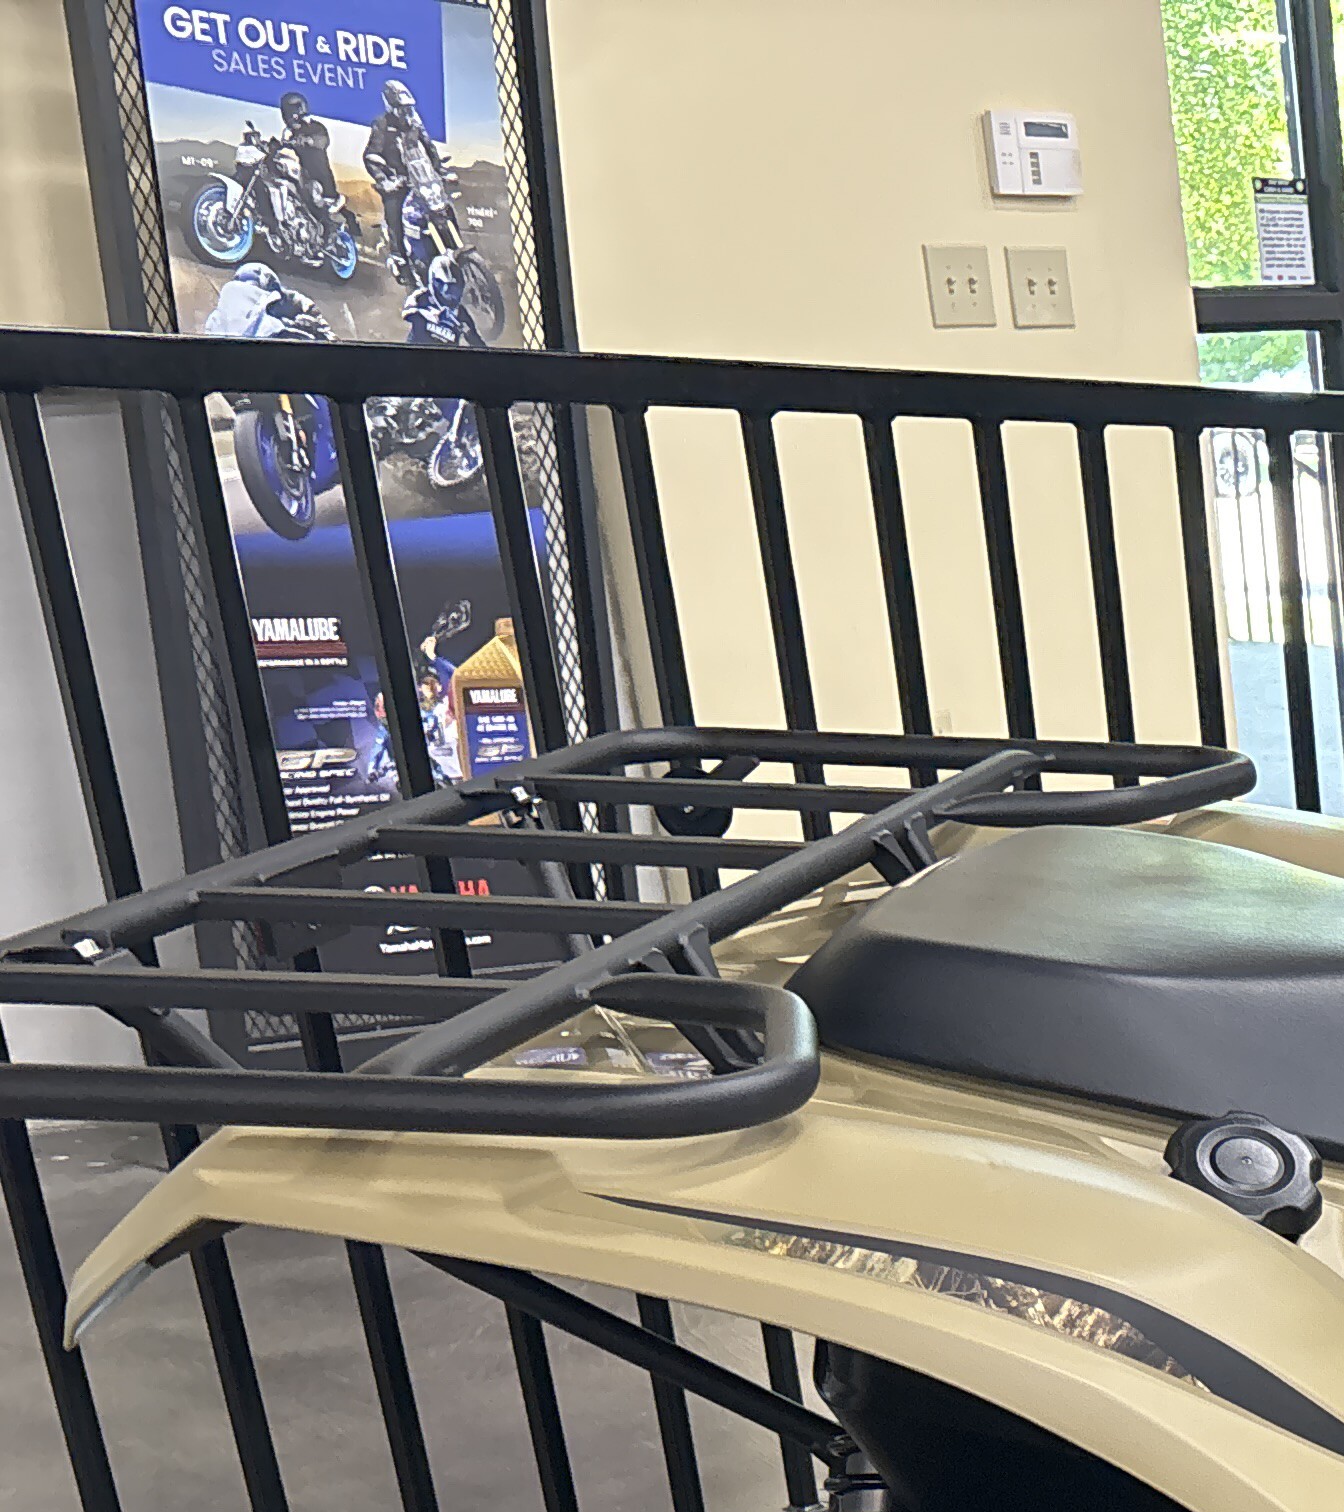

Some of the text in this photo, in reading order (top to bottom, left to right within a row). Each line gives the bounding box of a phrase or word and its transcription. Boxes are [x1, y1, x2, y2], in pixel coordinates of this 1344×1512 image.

[163, 6, 408, 69] GET OUT & RIDE
[212, 49, 367, 89] SALES EVENT
[252, 617, 340, 642] YAMALUBE
